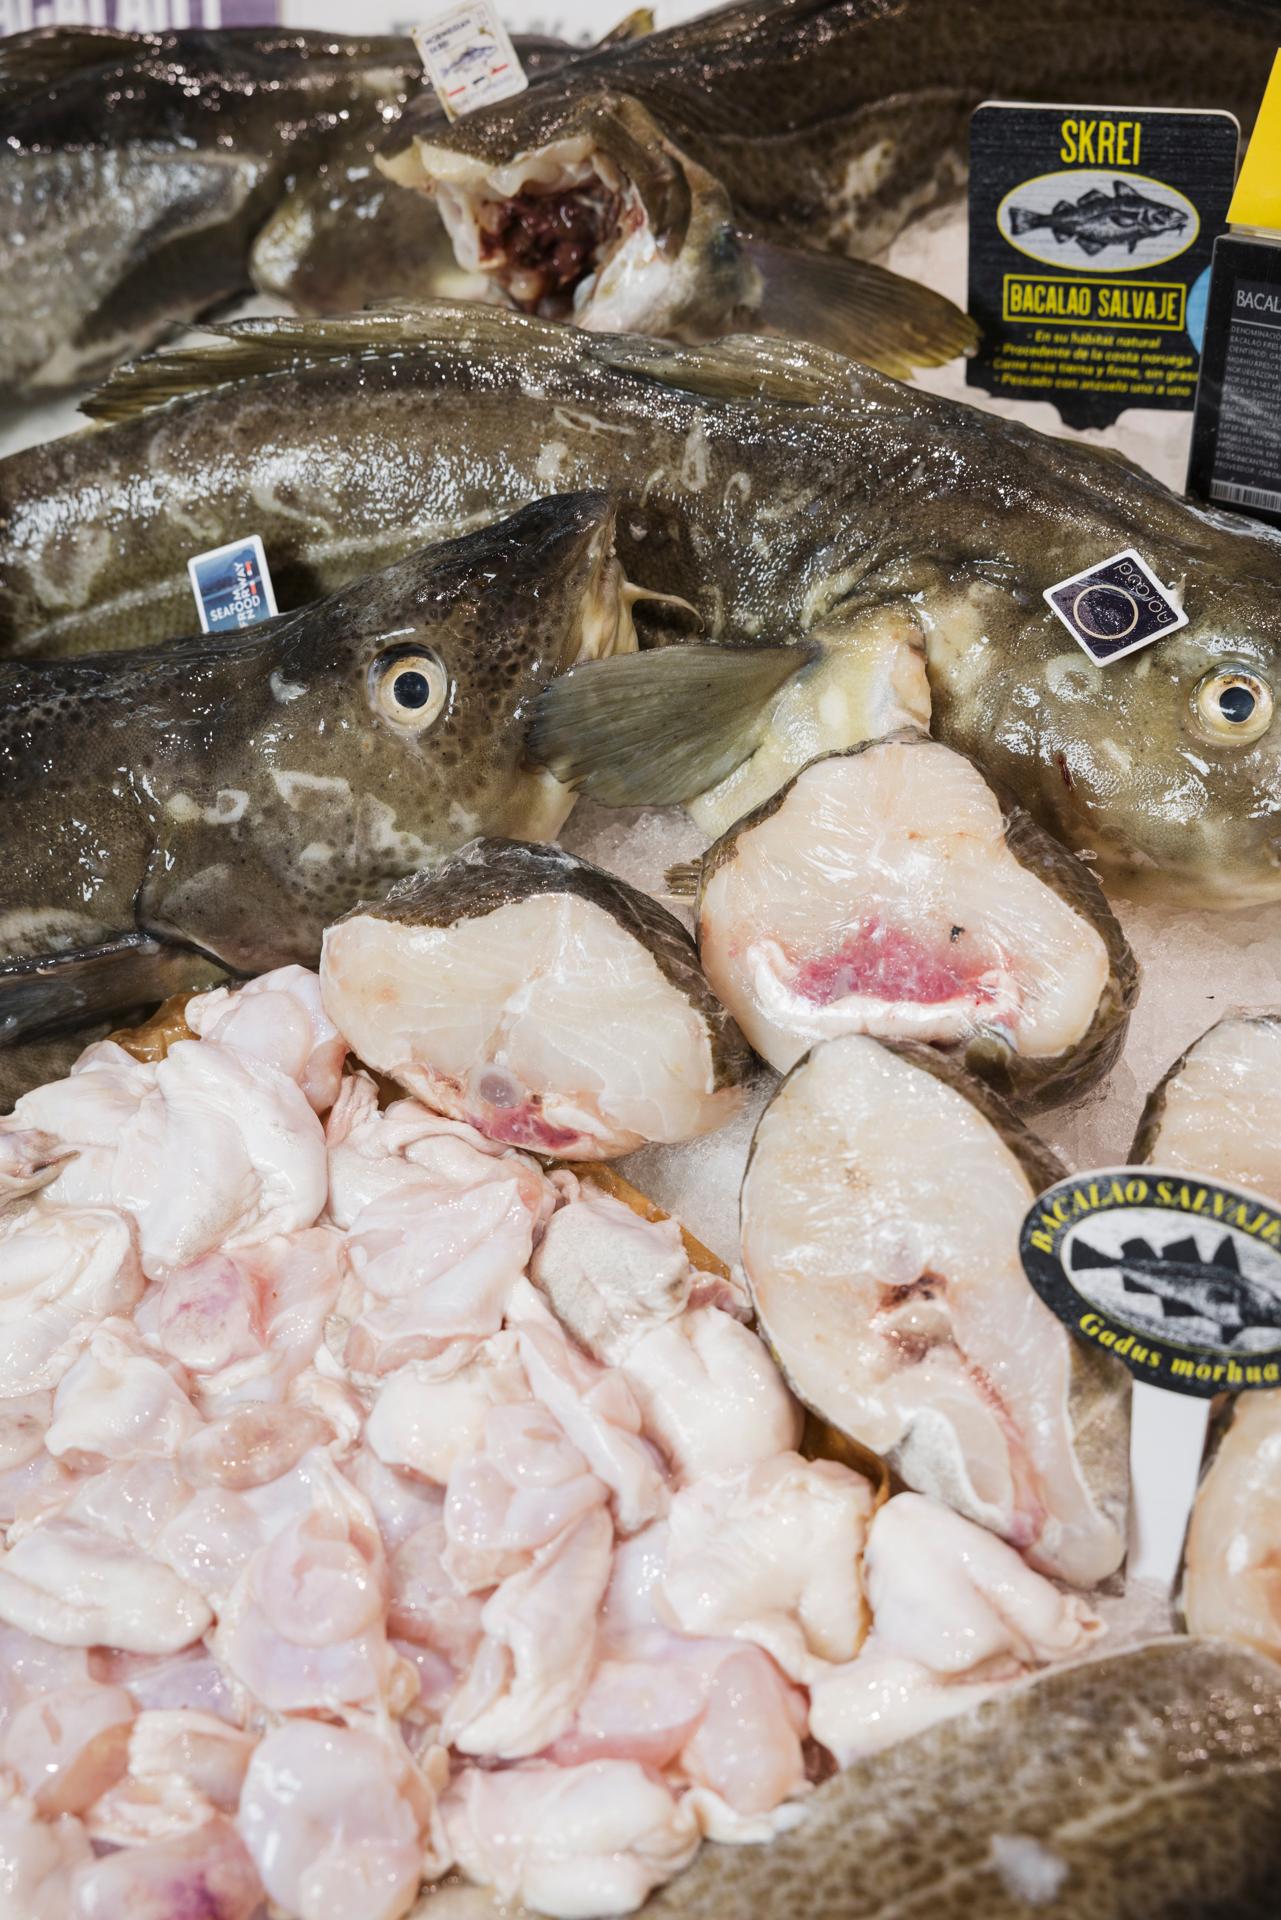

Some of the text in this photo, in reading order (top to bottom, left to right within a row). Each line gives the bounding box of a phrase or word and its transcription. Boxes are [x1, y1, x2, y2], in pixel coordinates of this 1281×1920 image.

[1060, 120, 1141, 165] SKREI
[1010, 283, 1179, 321] BACALAO SALVAJE
[210, 595, 260, 622] SEAFOOD
[1030, 1179, 1281, 1254] BACALAO SALVAJE
[1079, 1313, 1280, 1384] Gadus morhua
